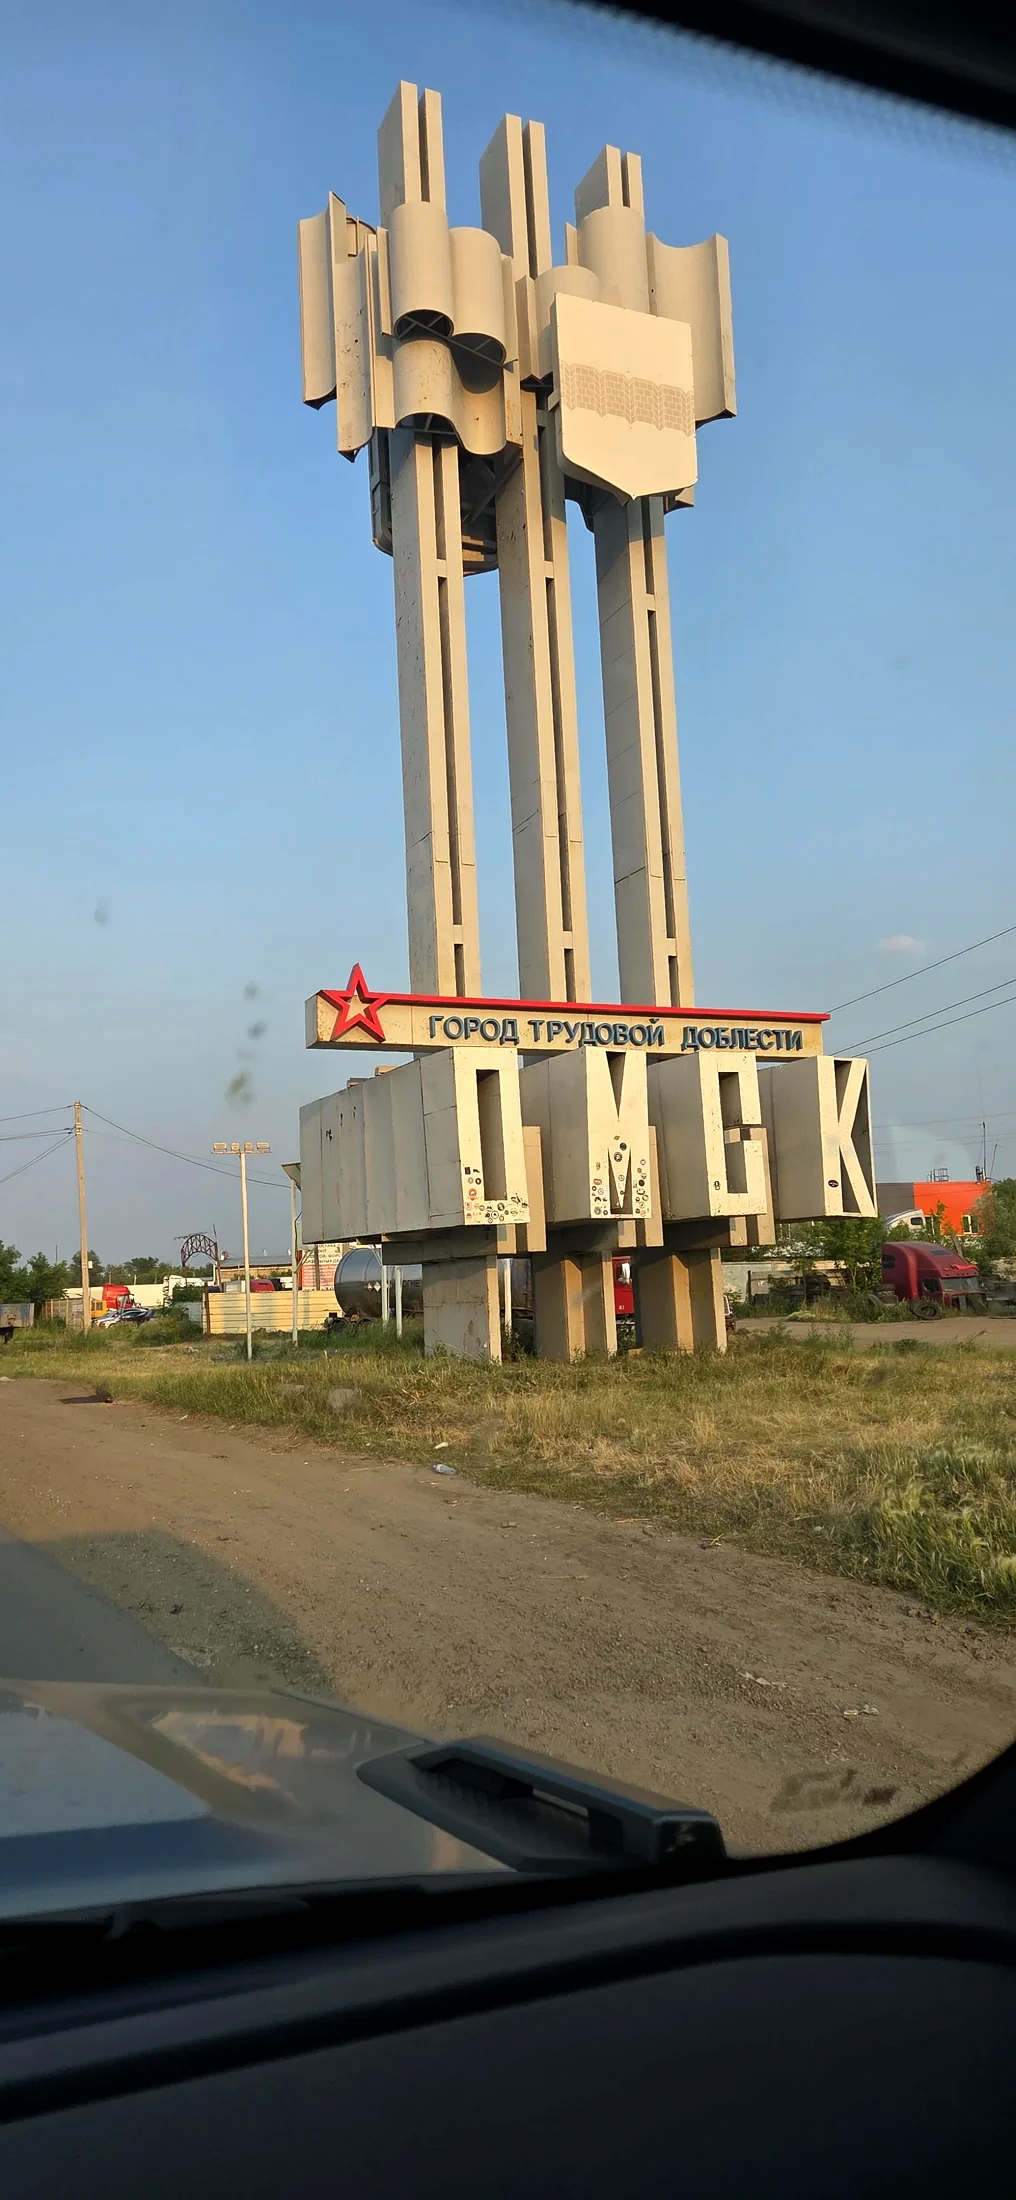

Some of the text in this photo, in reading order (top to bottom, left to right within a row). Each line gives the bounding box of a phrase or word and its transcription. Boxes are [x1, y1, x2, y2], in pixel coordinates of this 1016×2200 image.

[429, 1015, 804, 1052] ГОРОД ТРУДОВОЙ ДОБЛЕСТИ
[453, 1046, 877, 1226] ОМСК
